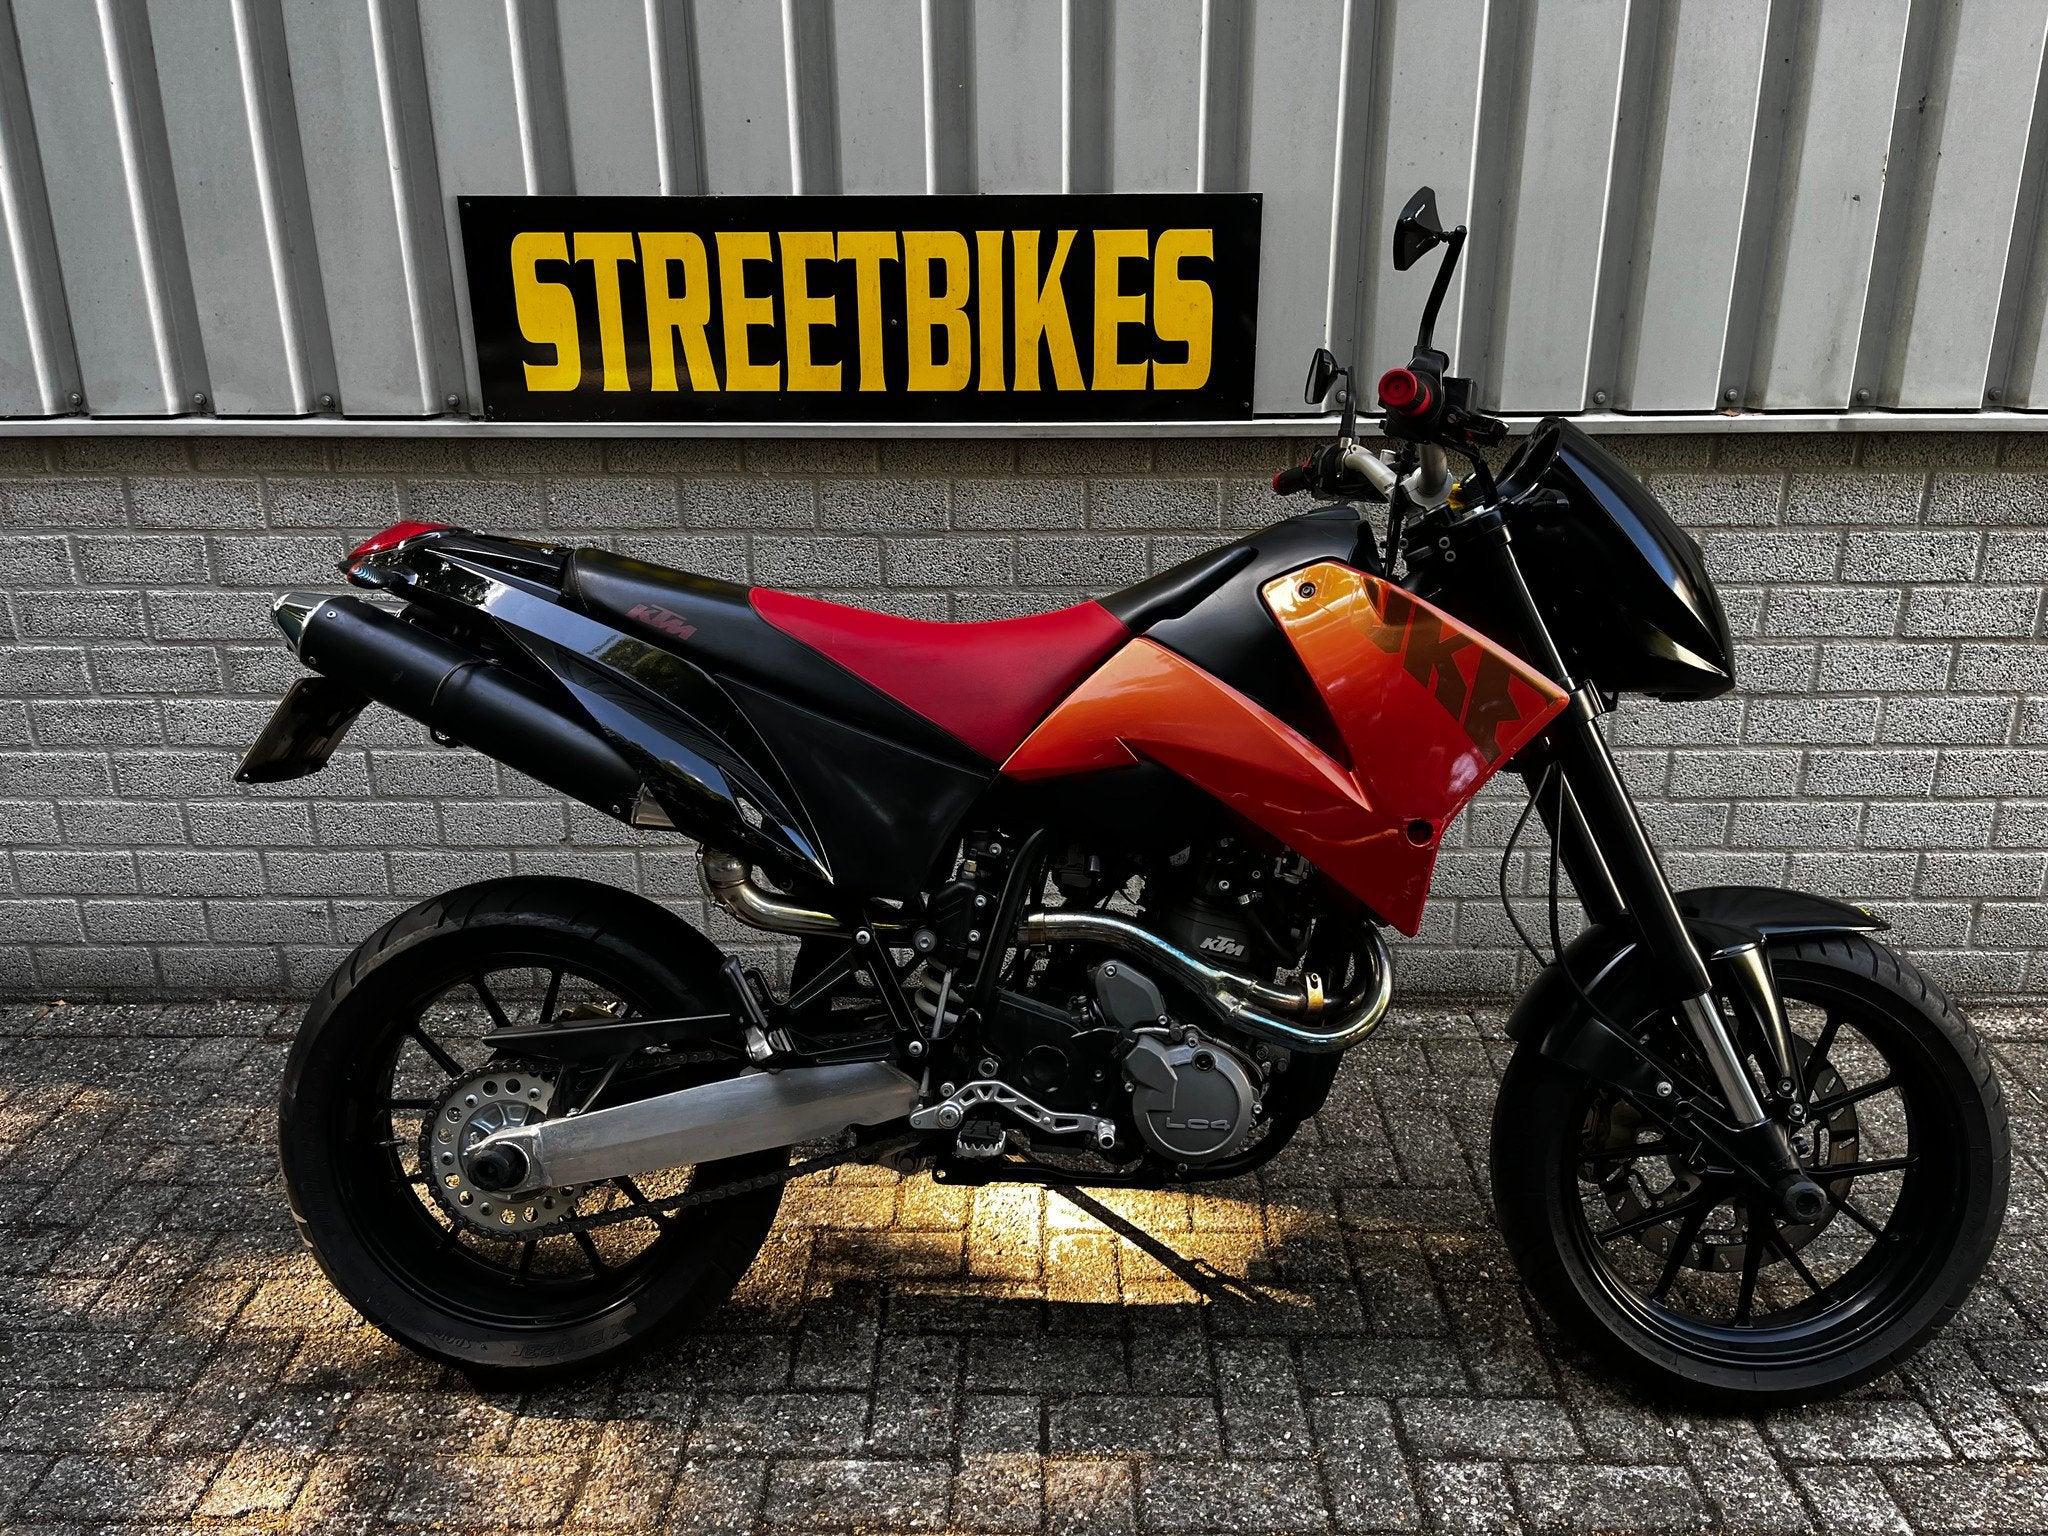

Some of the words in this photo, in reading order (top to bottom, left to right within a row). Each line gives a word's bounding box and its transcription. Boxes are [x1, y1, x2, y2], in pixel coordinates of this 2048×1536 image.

[511, 229, 1214, 392] STREETBIKES
[625, 603, 698, 640] KTM
[1200, 935, 1245, 956] KTM
[1166, 1116, 1231, 1131] LC4
